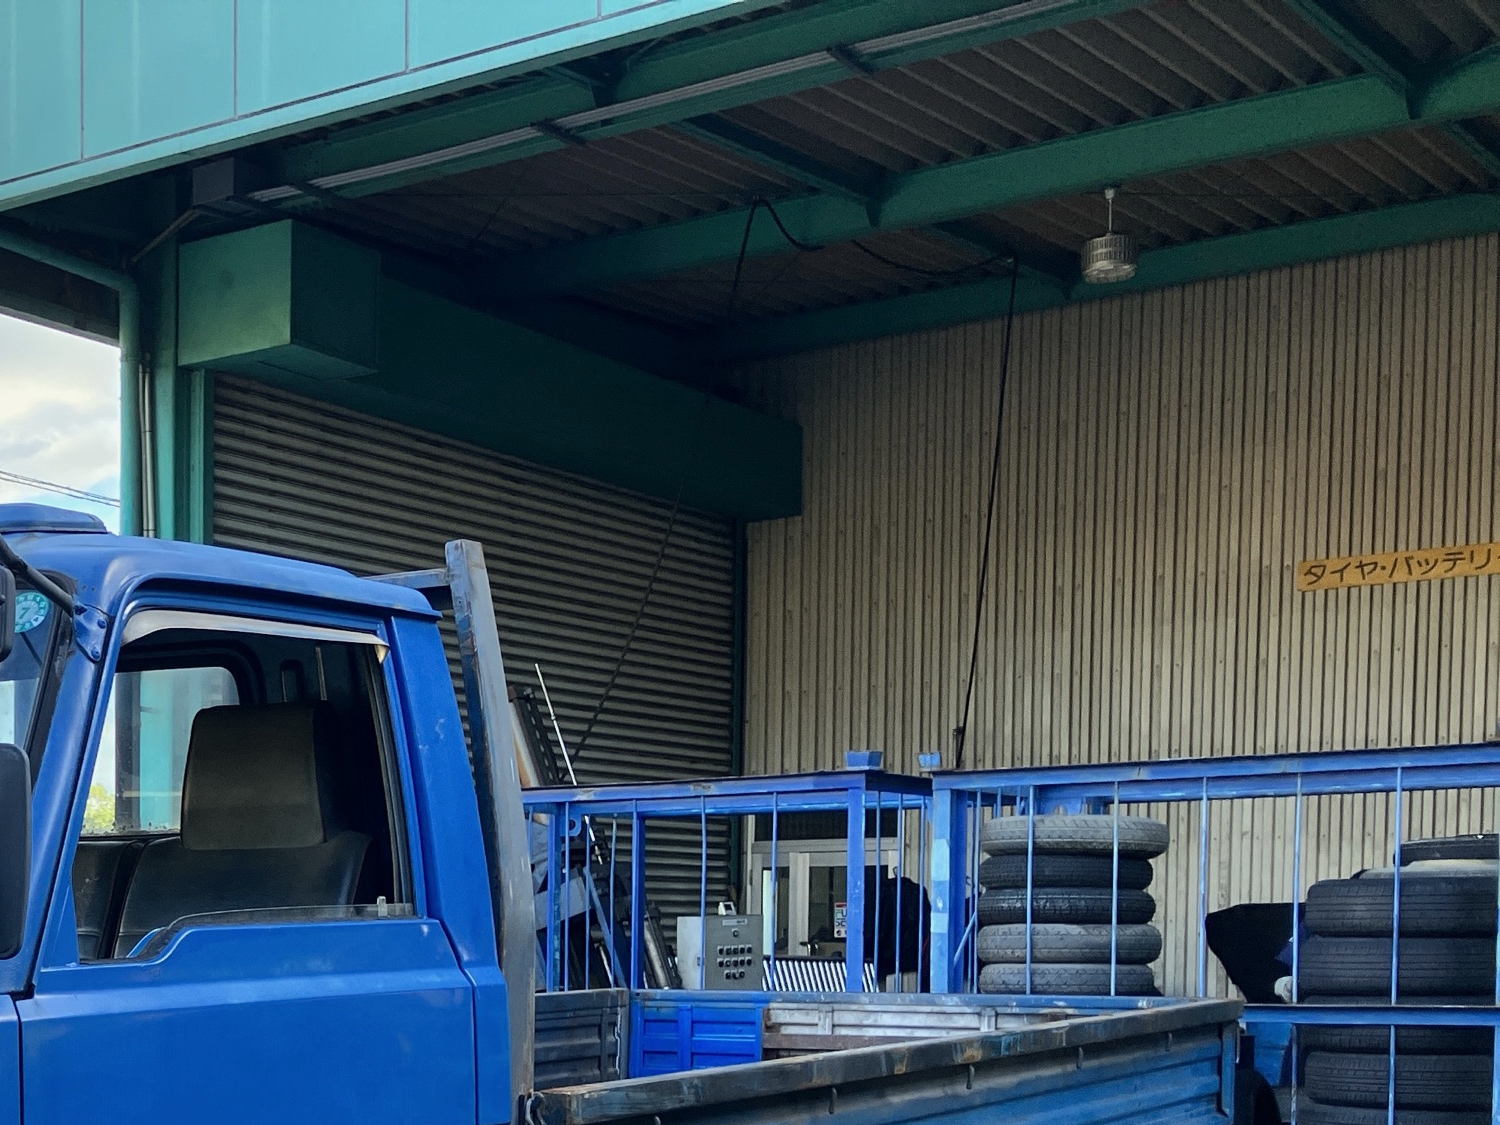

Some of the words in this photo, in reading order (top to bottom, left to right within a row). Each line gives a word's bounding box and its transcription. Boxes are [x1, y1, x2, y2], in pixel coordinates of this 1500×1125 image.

[1303, 548, 1500, 586] タイヤ・バッテリ
[18, 606, 31, 620] 7
